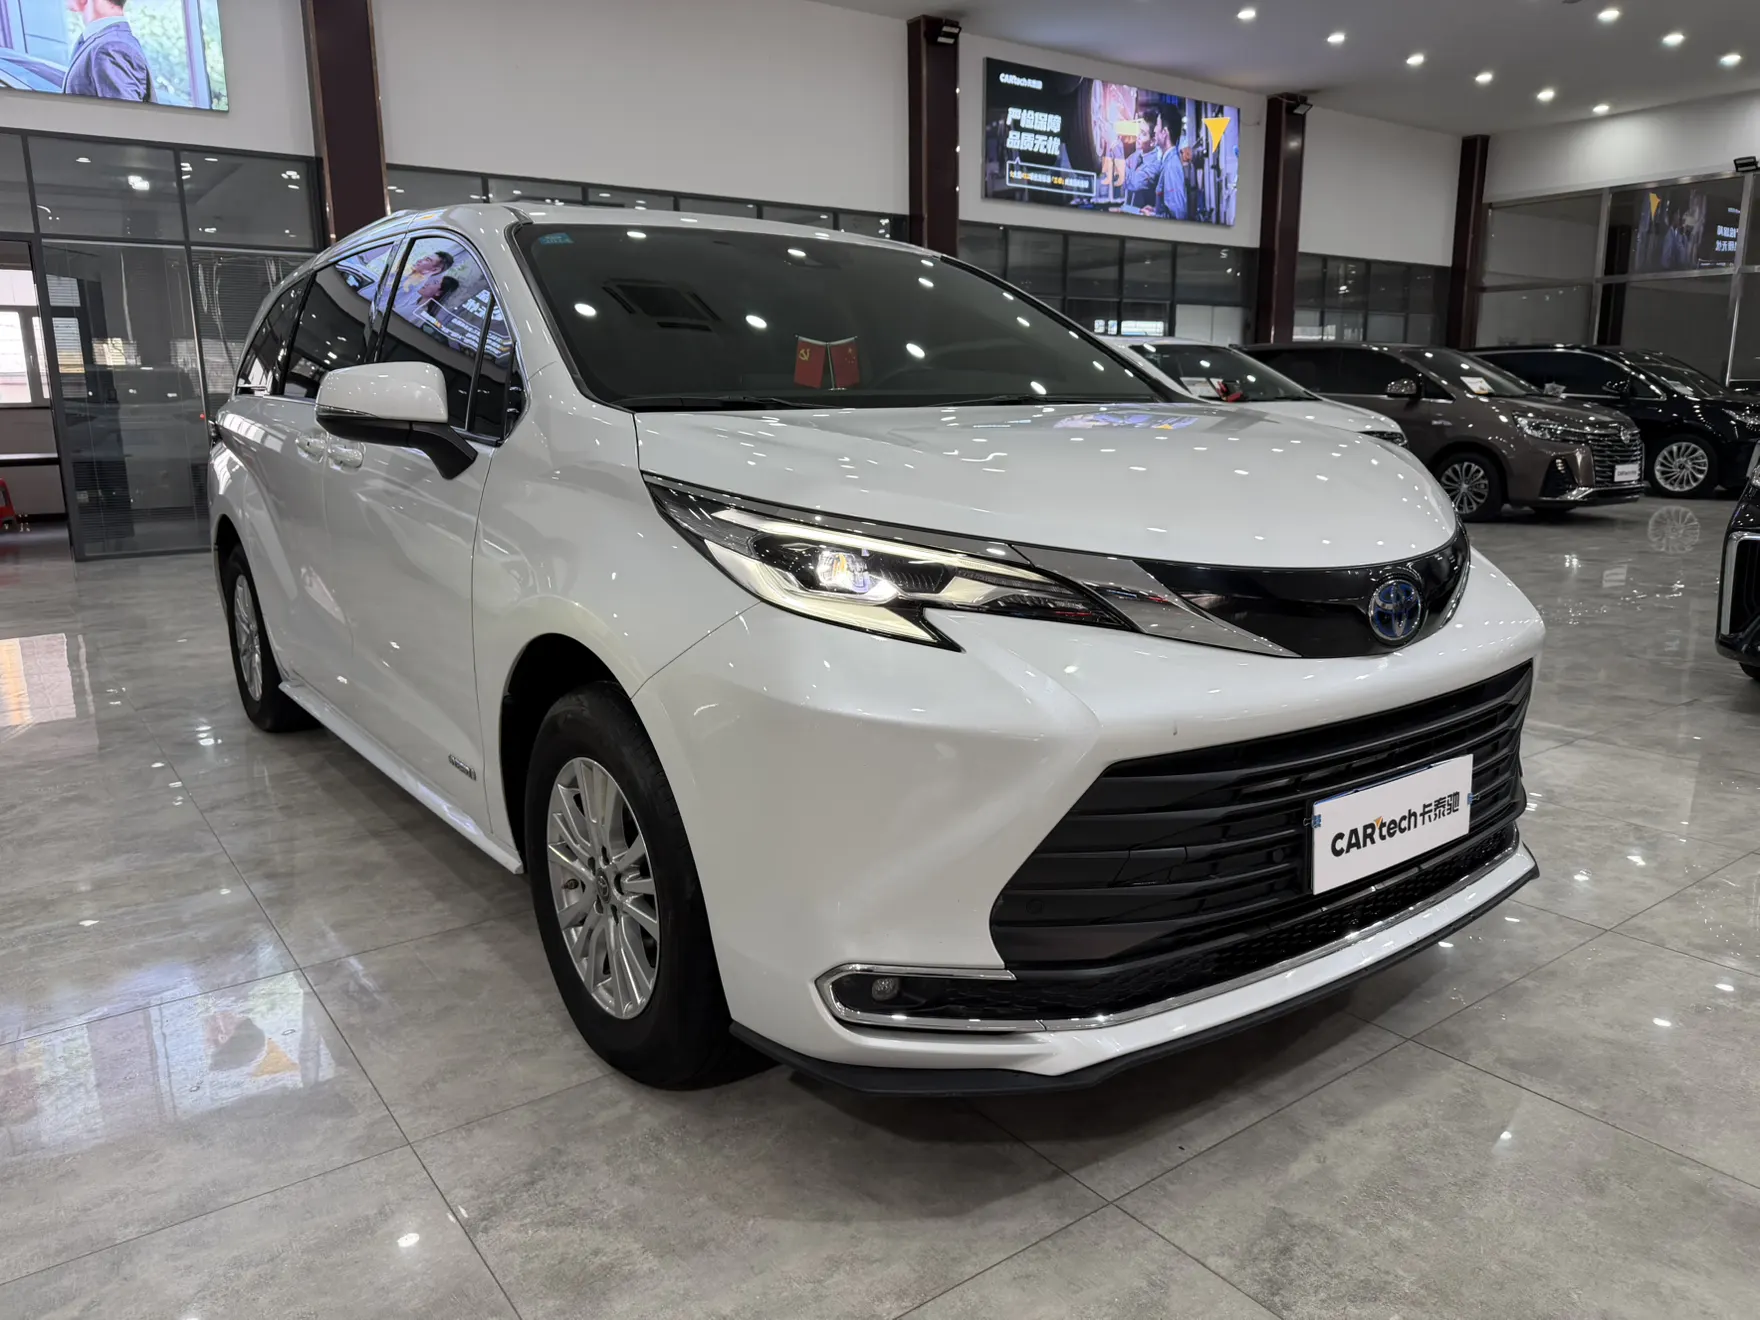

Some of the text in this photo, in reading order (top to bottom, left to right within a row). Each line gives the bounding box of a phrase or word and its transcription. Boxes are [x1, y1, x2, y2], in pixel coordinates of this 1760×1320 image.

[1006, 107, 1062, 133] 严检保障
[1006, 130, 1061, 155] 品质无忧
